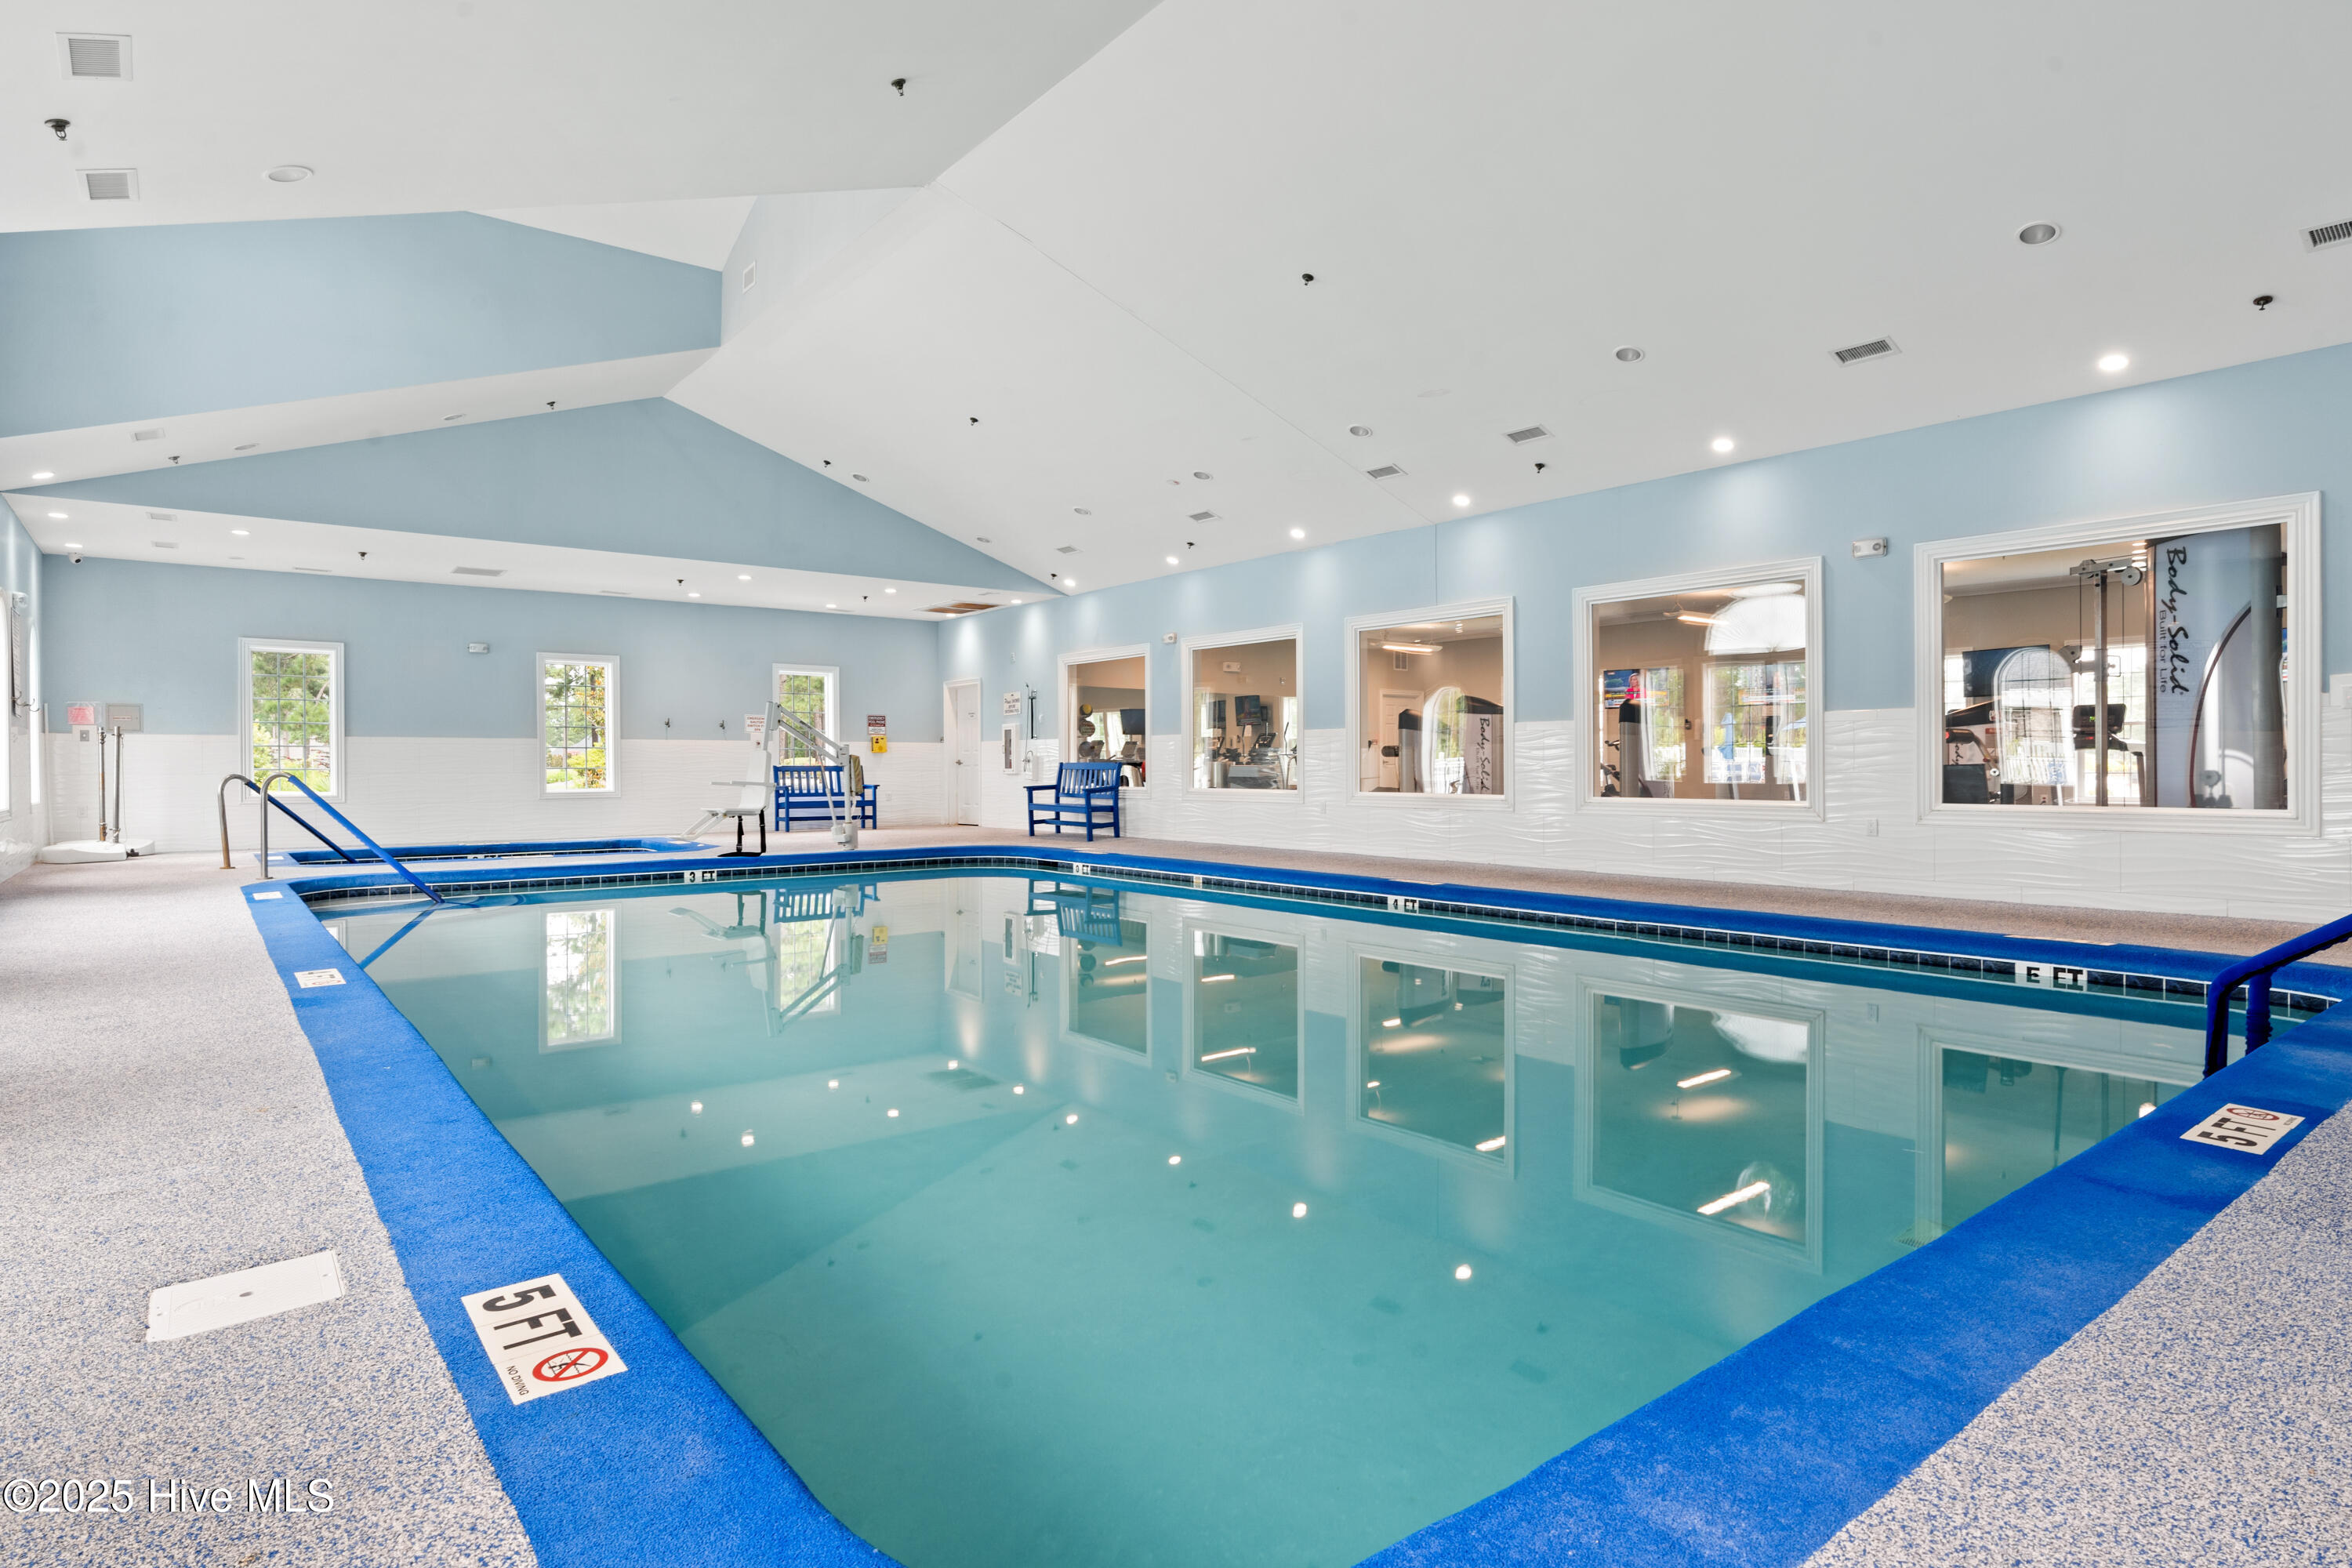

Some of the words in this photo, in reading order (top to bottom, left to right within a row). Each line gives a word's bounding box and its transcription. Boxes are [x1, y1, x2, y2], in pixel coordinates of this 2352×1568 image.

[2158, 609, 2167, 641] Built
[2161, 546, 2190, 695] Body-Solid
[2158, 643, 2167, 663] for
[2158, 668, 2168, 693] Life
[2211, 1116, 2277, 1138] FT
[2196, 1131, 2258, 1147] 5
[481, 1283, 557, 1312] 5
[492, 1307, 583, 1351] FT
[506, 1365, 518, 1375] NO
[511, 1375, 529, 1396] DIVING
